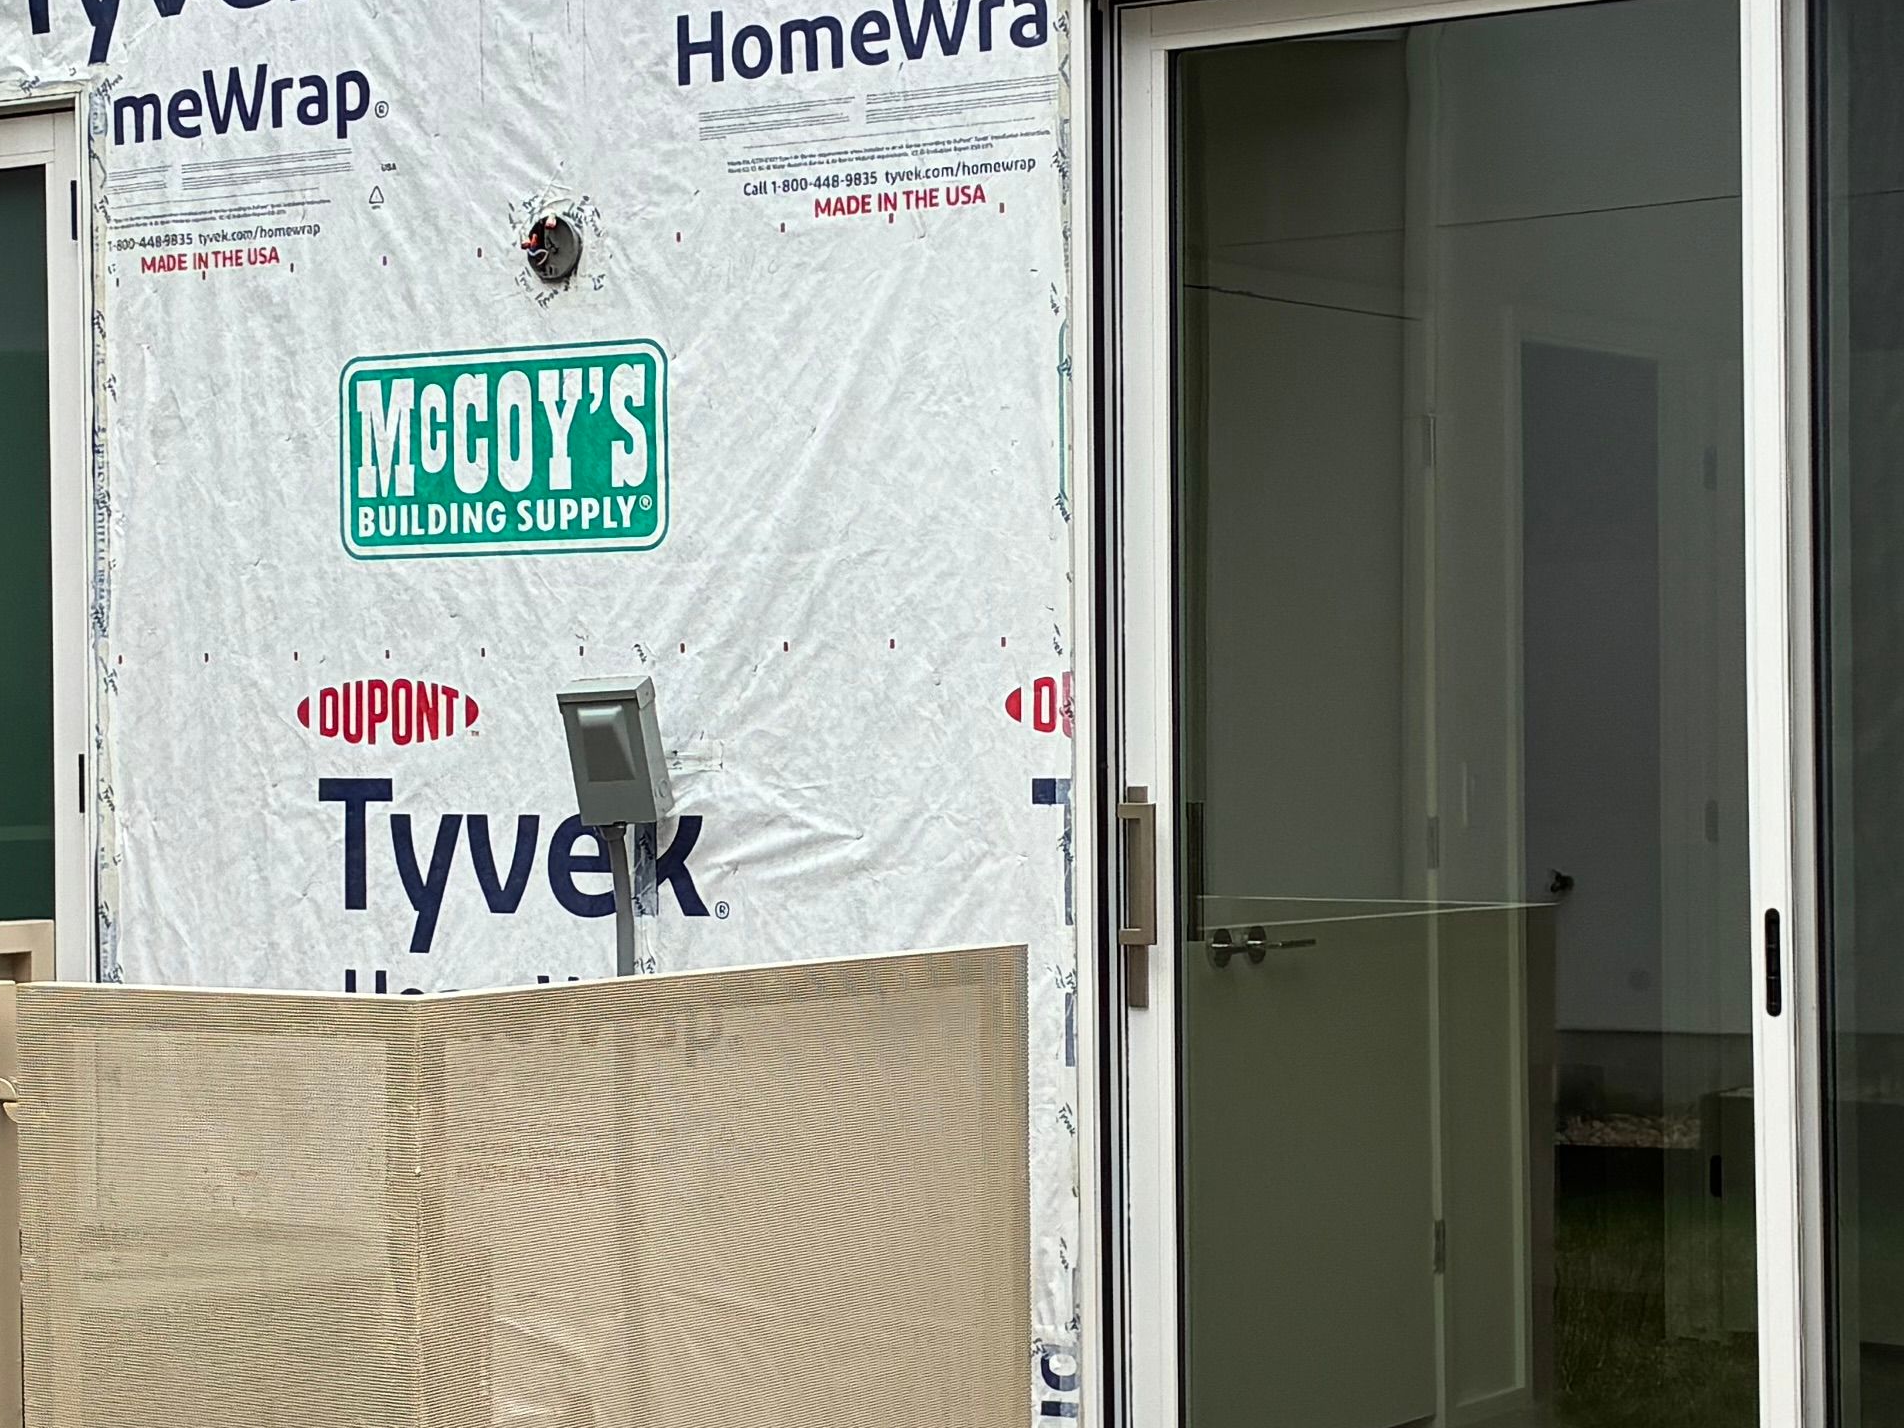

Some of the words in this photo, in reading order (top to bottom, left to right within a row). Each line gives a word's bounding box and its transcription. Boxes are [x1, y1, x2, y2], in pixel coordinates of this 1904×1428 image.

[113, 63, 371, 145] meWrap
[744, 181, 767, 196] Call
[771, 172, 877, 194] 1-800-448-9835
[885, 157, 1036, 184] tyvek.com/homewrap
[814, 194, 871, 217] MADE
[878, 192, 896, 213] IN
[903, 188, 938, 210] THE
[946, 184, 985, 206] USA
[141, 254, 187, 273] MADE
[193, 252, 208, 269] IN
[213, 250, 243, 269] THE
[248, 246, 279, 265] USA
[358, 501, 507, 538] BUILDING
[517, 494, 637, 532] SUPPLY
[319, 678, 460, 745] DUPONT
